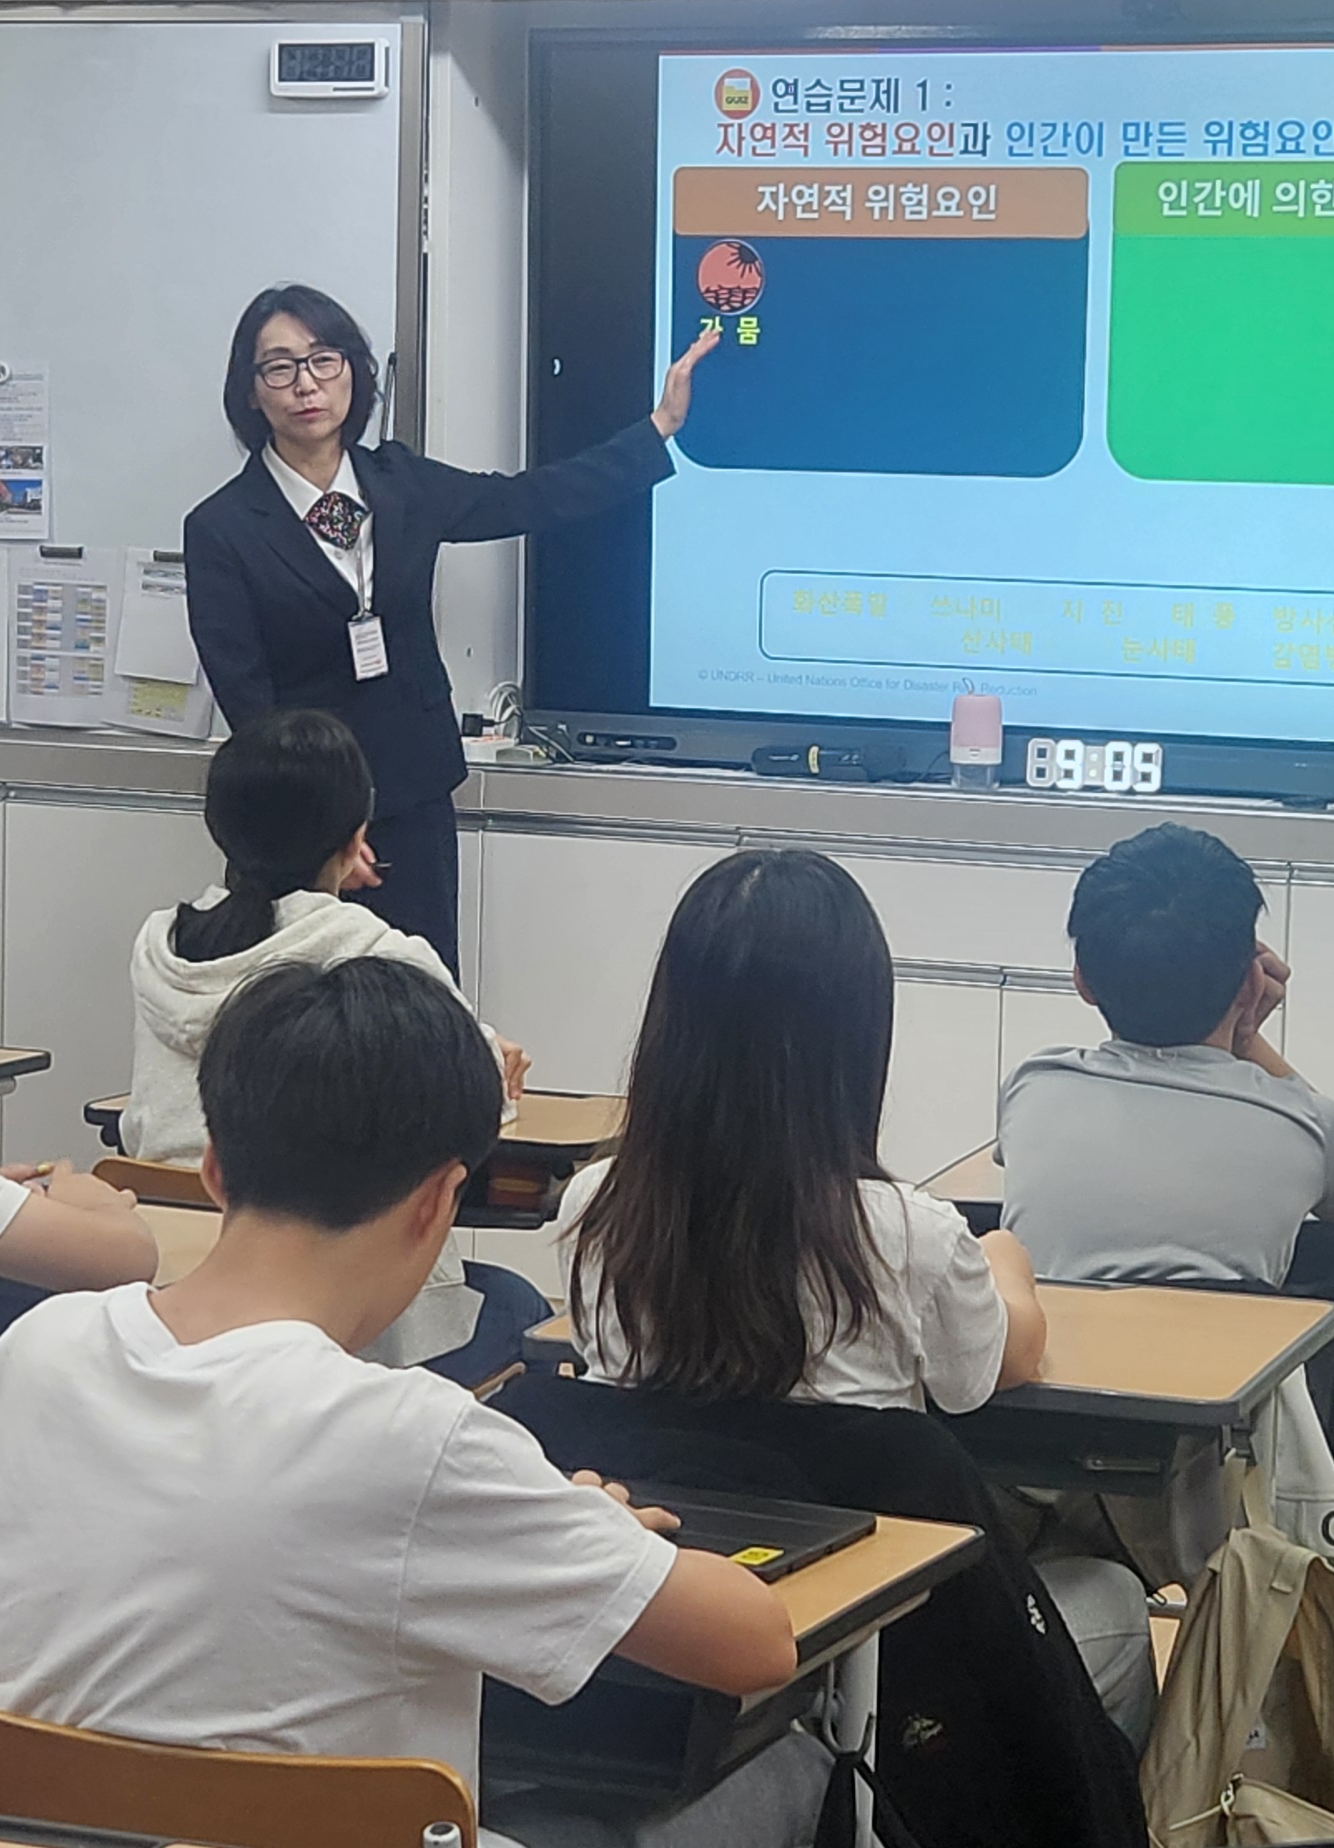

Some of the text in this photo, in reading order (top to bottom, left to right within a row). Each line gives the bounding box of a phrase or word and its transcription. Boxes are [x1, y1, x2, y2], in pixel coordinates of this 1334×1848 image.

[771, 77, 901, 113] 연습문제
[916, 78, 929, 112] 1
[715, 122, 810, 158] 자연적
[825, 121, 991, 158] 위험요인과
[1006, 121, 1104, 158] 인간이
[1122, 121, 1187, 157] 만든
[757, 183, 997, 221] 자연적 위험요인
[1157, 179, 1261, 219] 인간에
[929, 595, 1001, 623] 쓰나미
[962, 629, 1032, 656] 산사태
[768, 672, 803, 686] United
[806, 674, 847, 688] Nations
[850, 676, 883, 690] Office
[886, 678, 900, 690] for
[904, 679, 949, 692] Disaster
[981, 683, 1037, 697] Reduction
